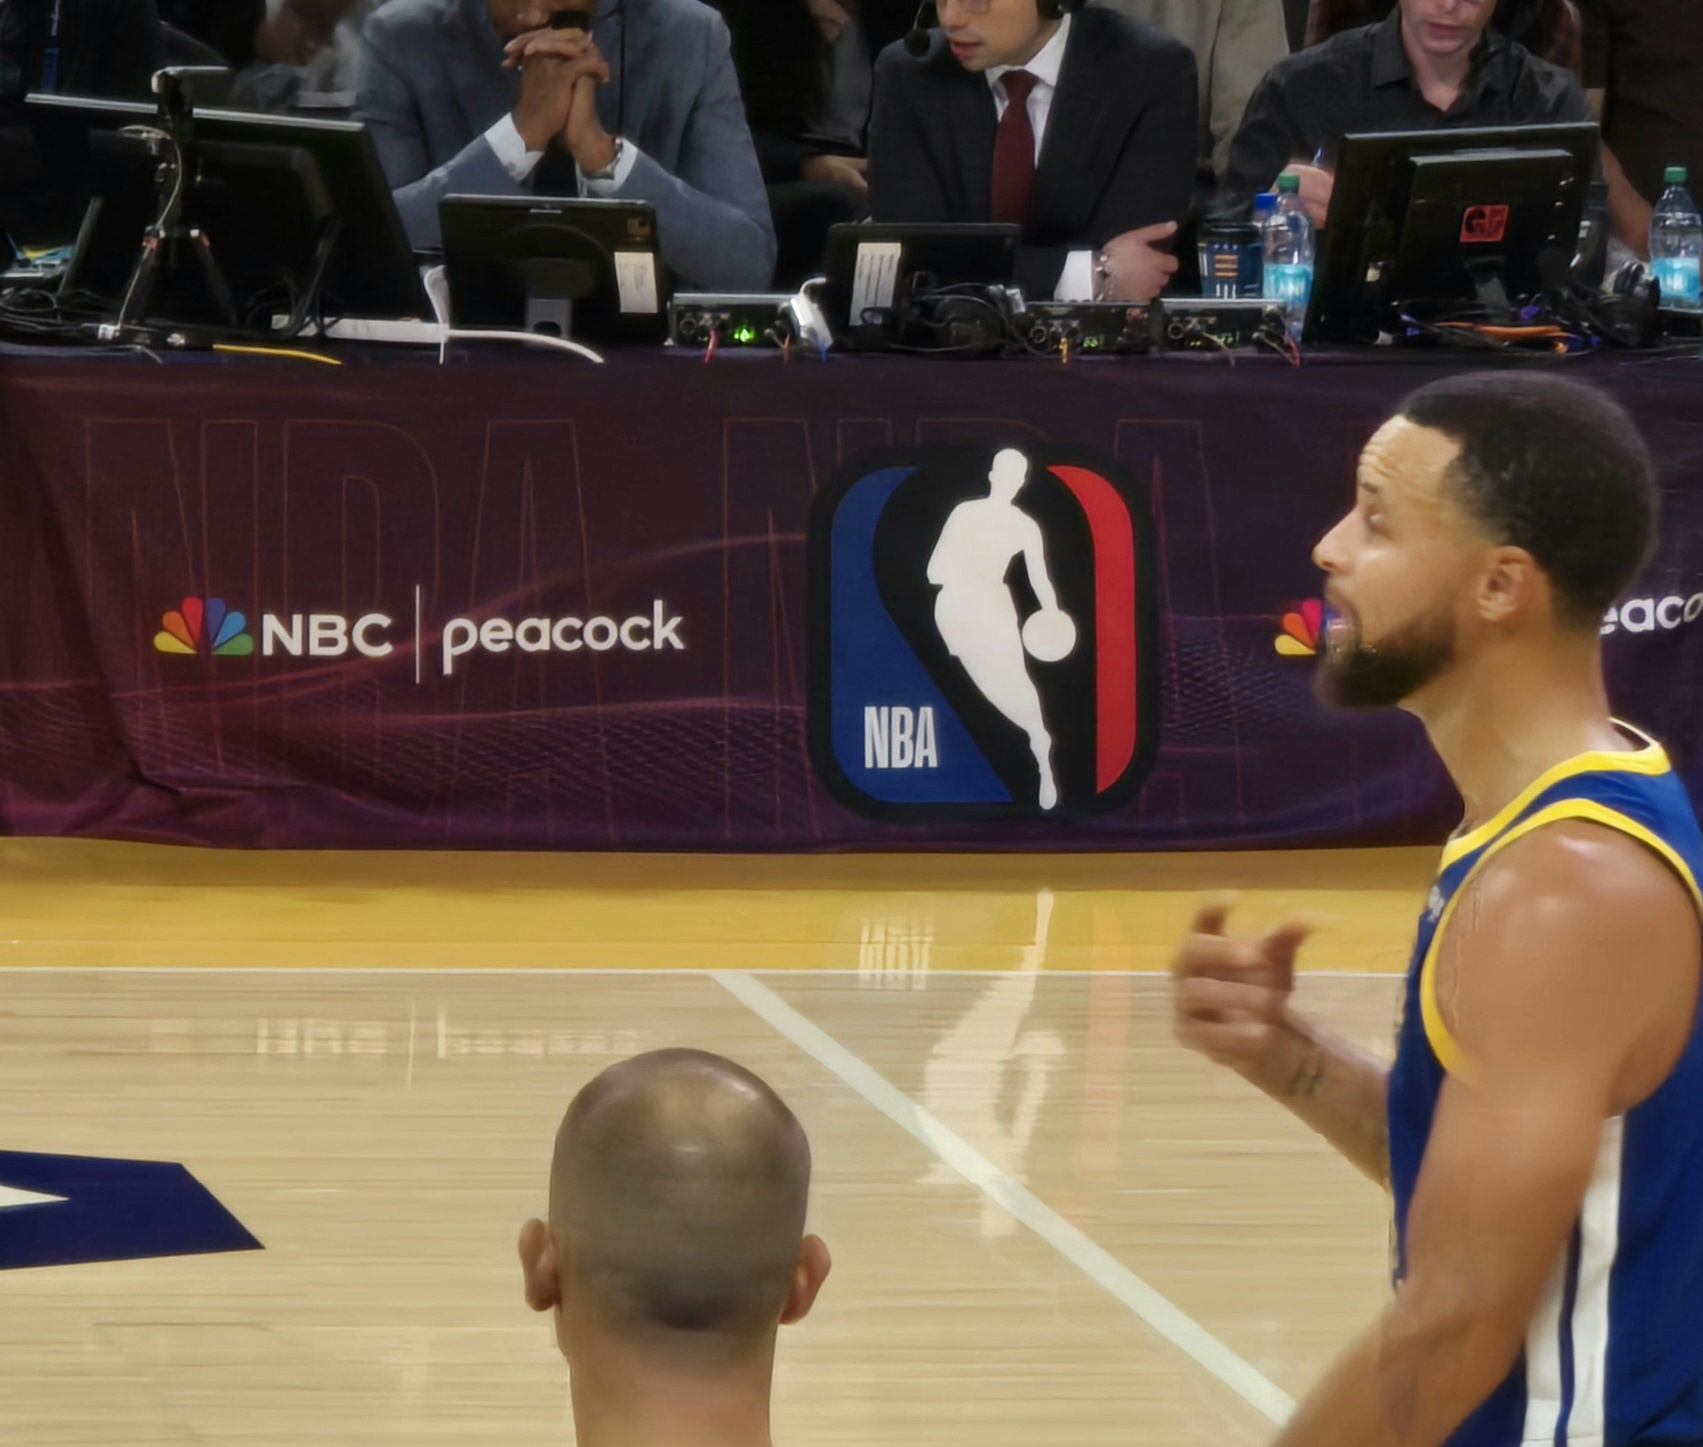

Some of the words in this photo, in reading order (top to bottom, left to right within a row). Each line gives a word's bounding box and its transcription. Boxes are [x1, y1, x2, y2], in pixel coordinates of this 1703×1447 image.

[261, 613, 393, 658] NBC
[441, 599, 685, 676] peacock
[864, 704, 938, 769] NBA
